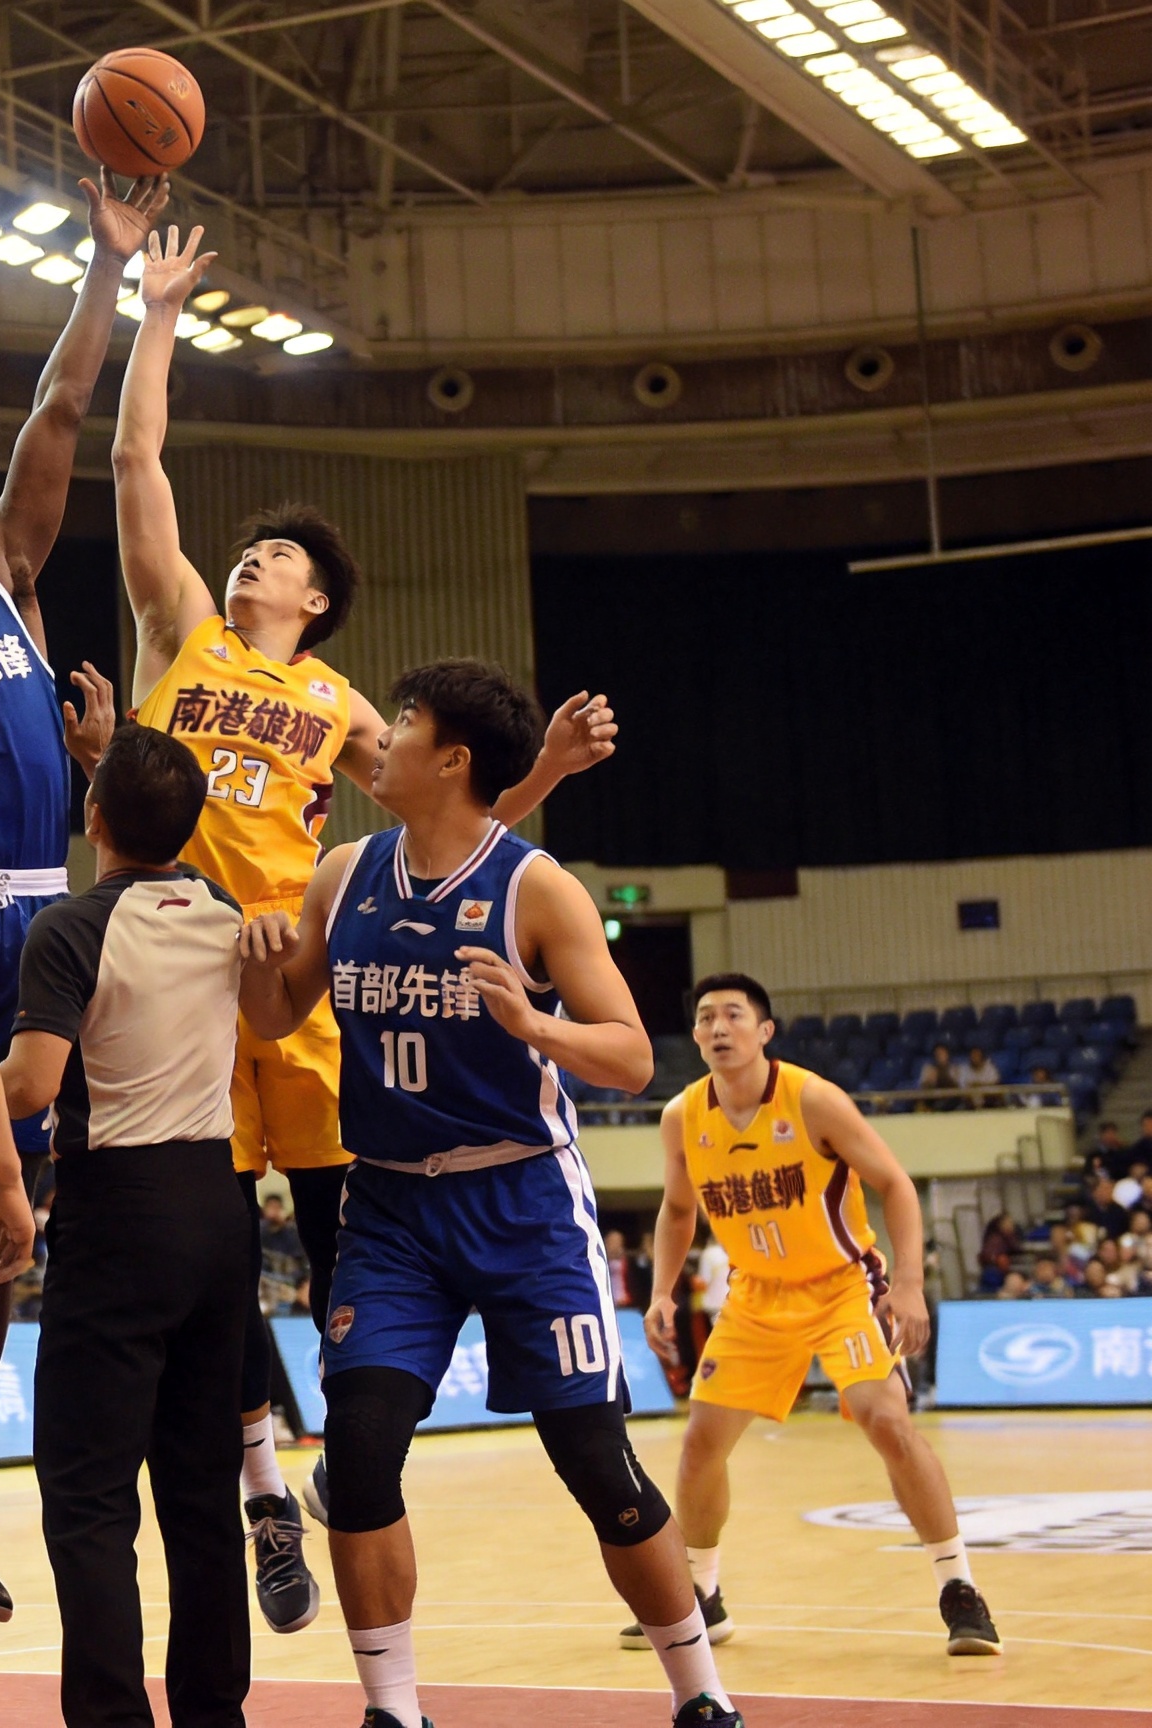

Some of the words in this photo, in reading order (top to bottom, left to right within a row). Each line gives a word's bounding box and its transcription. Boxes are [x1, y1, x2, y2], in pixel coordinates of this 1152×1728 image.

[167, 683, 333, 766] 南港雄狮
[206, 747, 271, 808] 23
[332, 958, 480, 1021] 首部先锋
[380, 1030, 428, 1092] 10
[550, 1314, 605, 1377] 10
